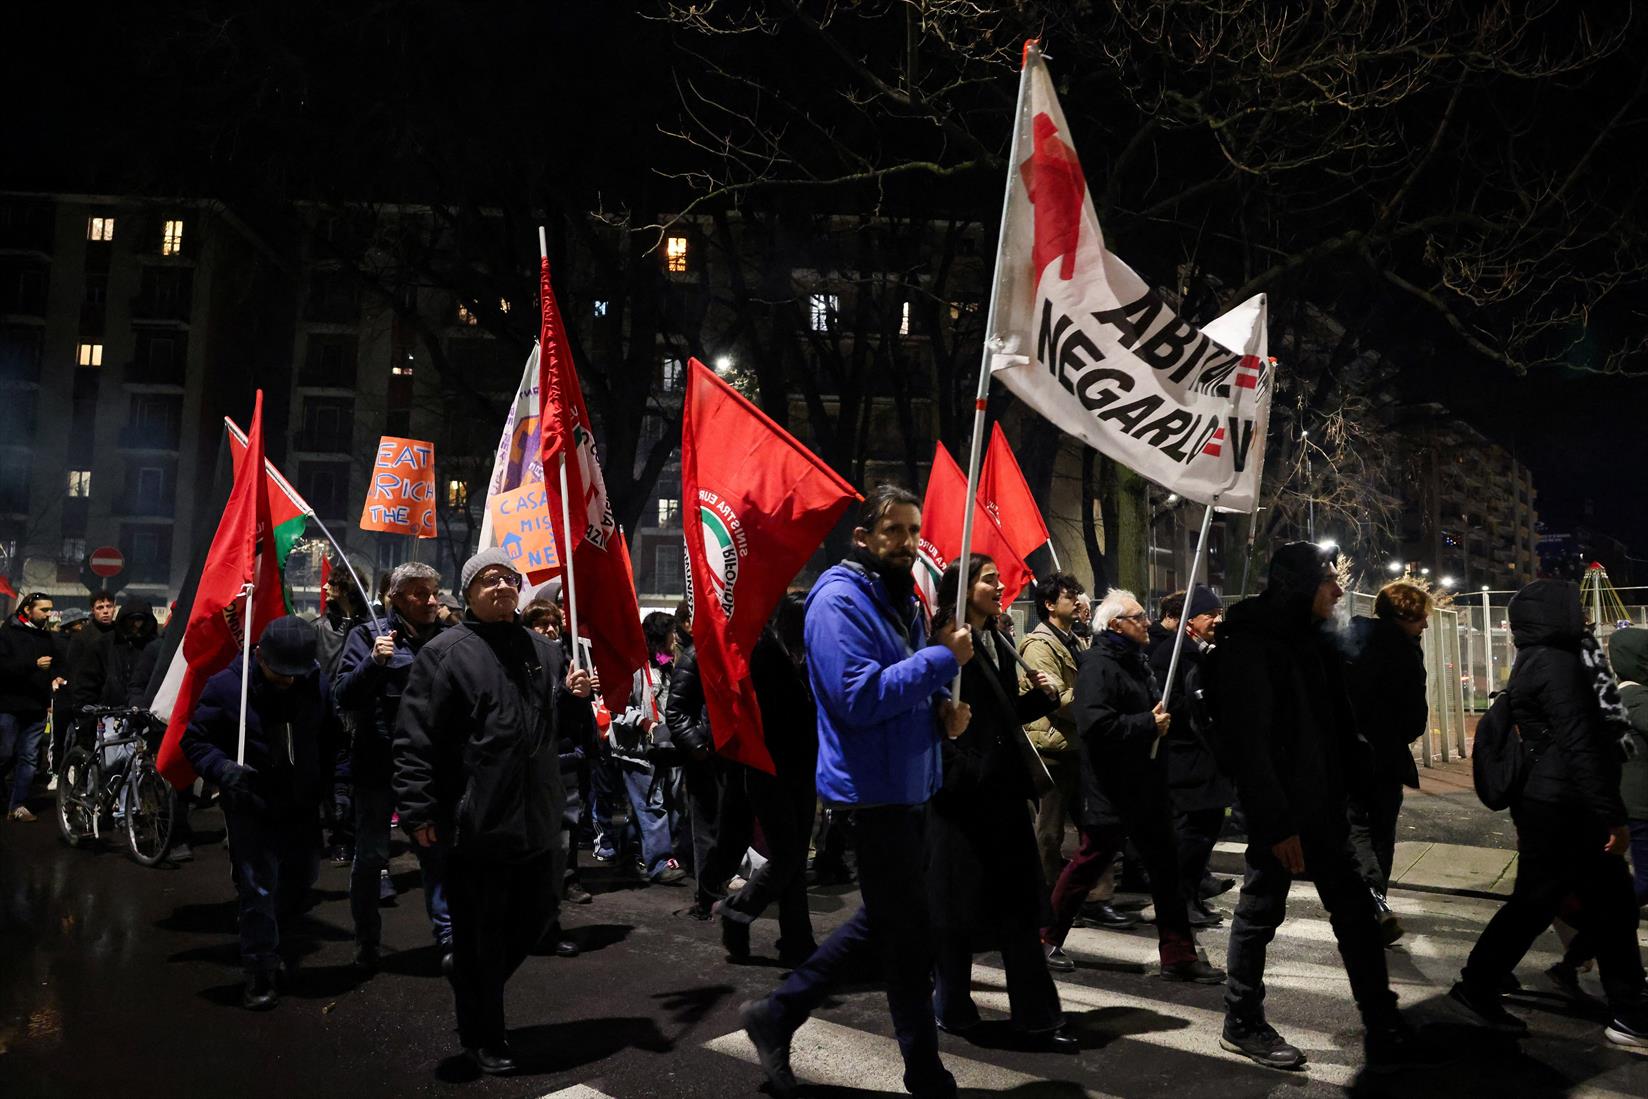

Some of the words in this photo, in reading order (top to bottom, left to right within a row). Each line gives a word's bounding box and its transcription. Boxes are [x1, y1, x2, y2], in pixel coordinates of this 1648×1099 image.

[1037, 297, 1219, 465] NEGARLO
[375, 441, 432, 469] EAT
[374, 473, 435, 502] RICH
[369, 504, 410, 525] THE
[500, 490, 549, 516] CASA
[520, 516, 553, 533] MIS
[528, 546, 556, 568] NE
